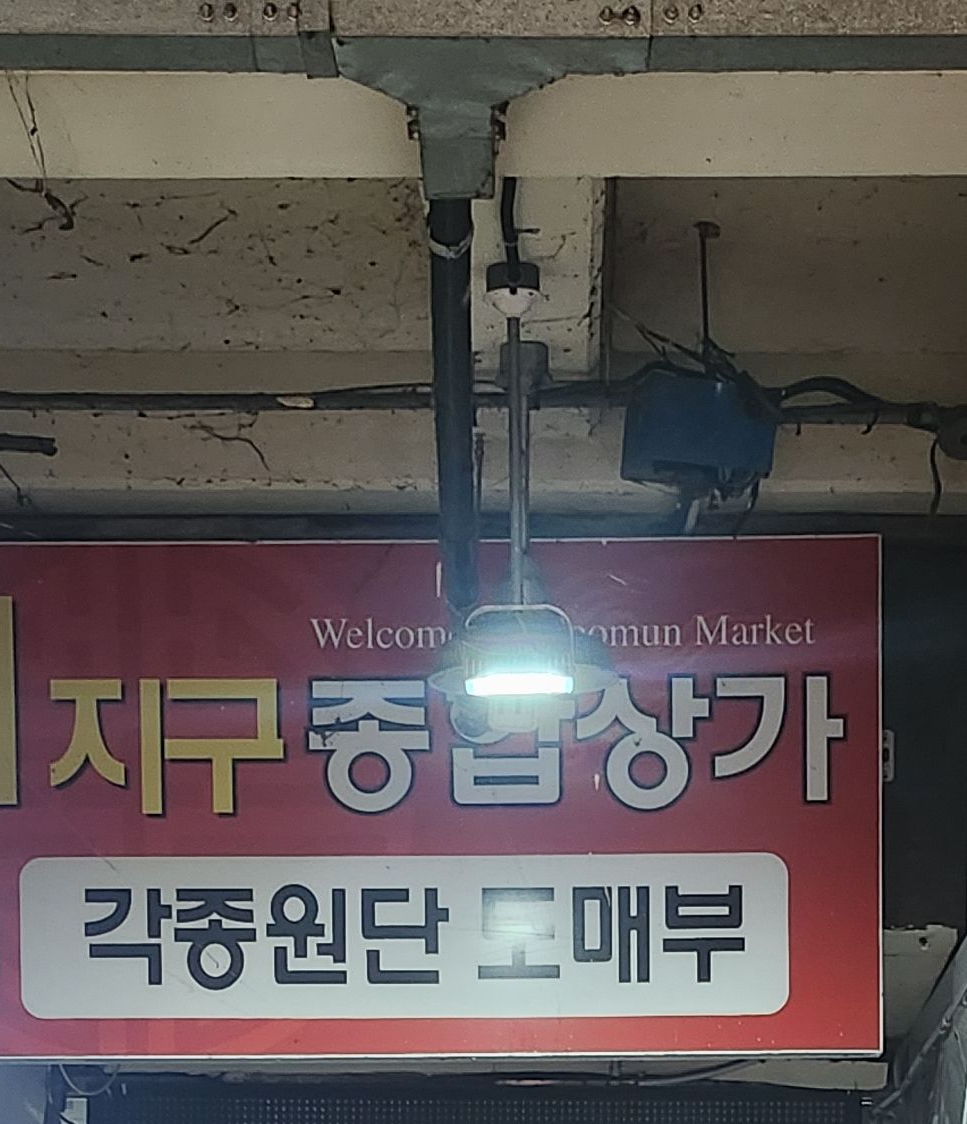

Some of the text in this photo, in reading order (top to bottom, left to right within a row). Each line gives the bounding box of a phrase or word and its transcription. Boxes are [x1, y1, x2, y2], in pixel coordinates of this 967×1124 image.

[310, 617, 452, 649] Welcom
[695, 613, 815, 648] Market
[83, 883, 746, 991] 각종원단 도매부
